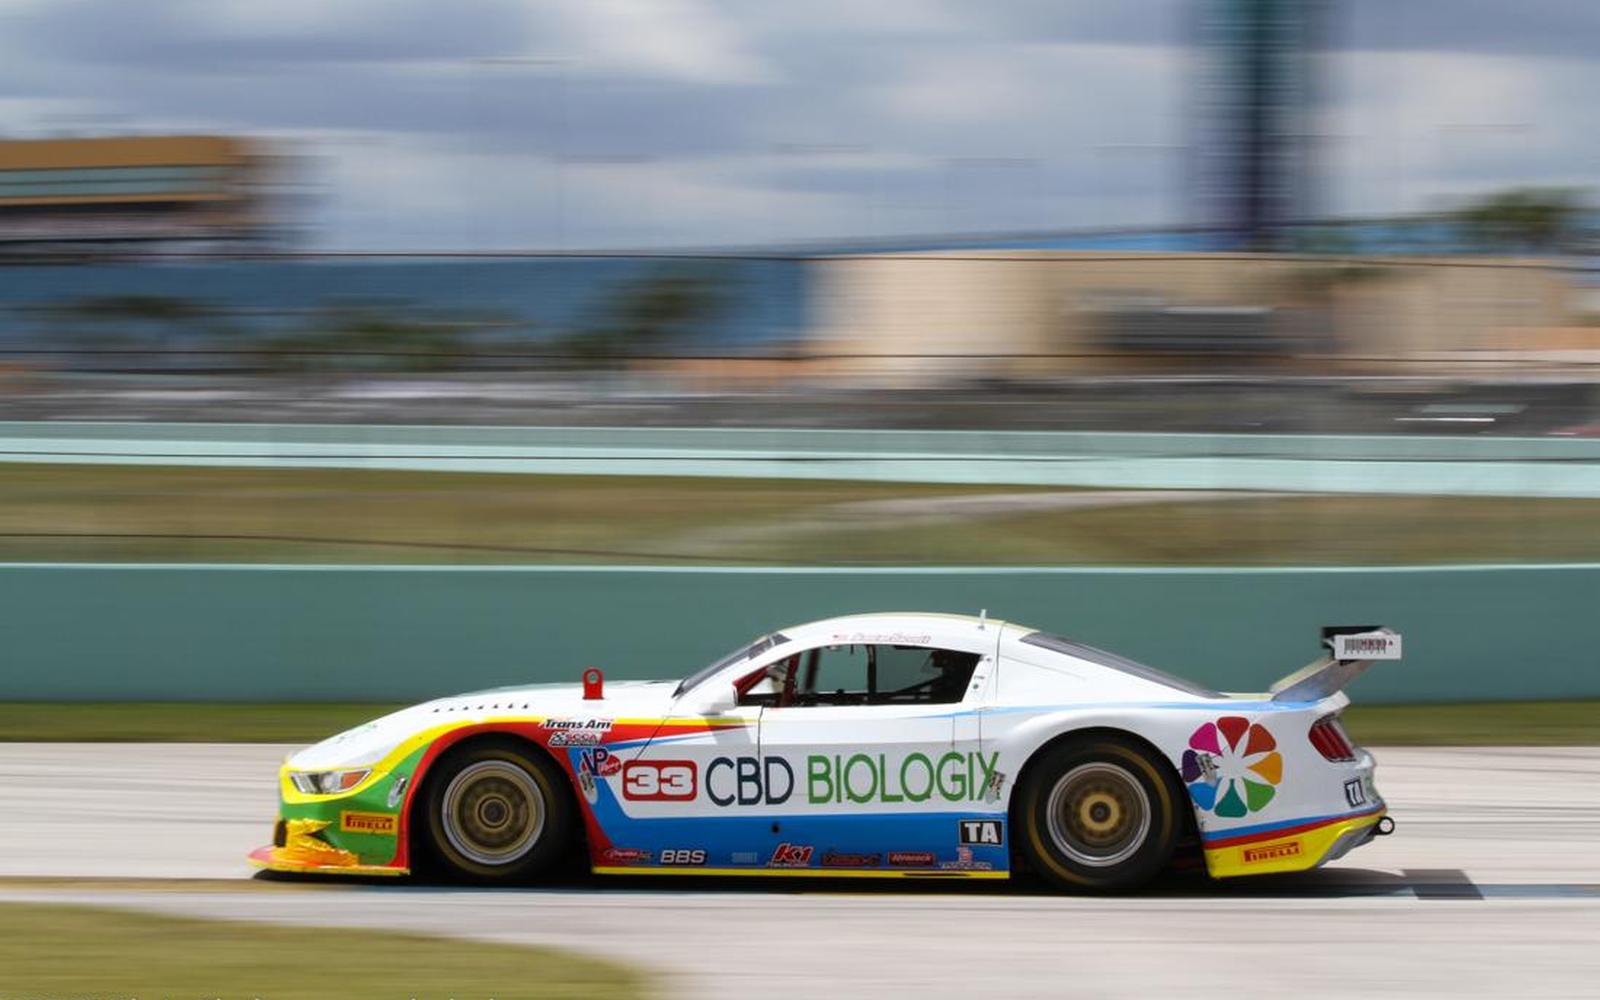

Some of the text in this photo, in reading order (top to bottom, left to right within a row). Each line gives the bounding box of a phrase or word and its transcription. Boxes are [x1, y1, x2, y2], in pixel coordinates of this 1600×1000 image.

[545, 719, 612, 729] Trans Am
[625, 765, 694, 796] 33
[705, 751, 1001, 806] CBD BIOLOGIX
[345, 815, 393, 830] PIRELLI
[964, 822, 999, 843] TA
[659, 849, 707, 864] BBS
[1244, 842, 1299, 862] PIRELLI
